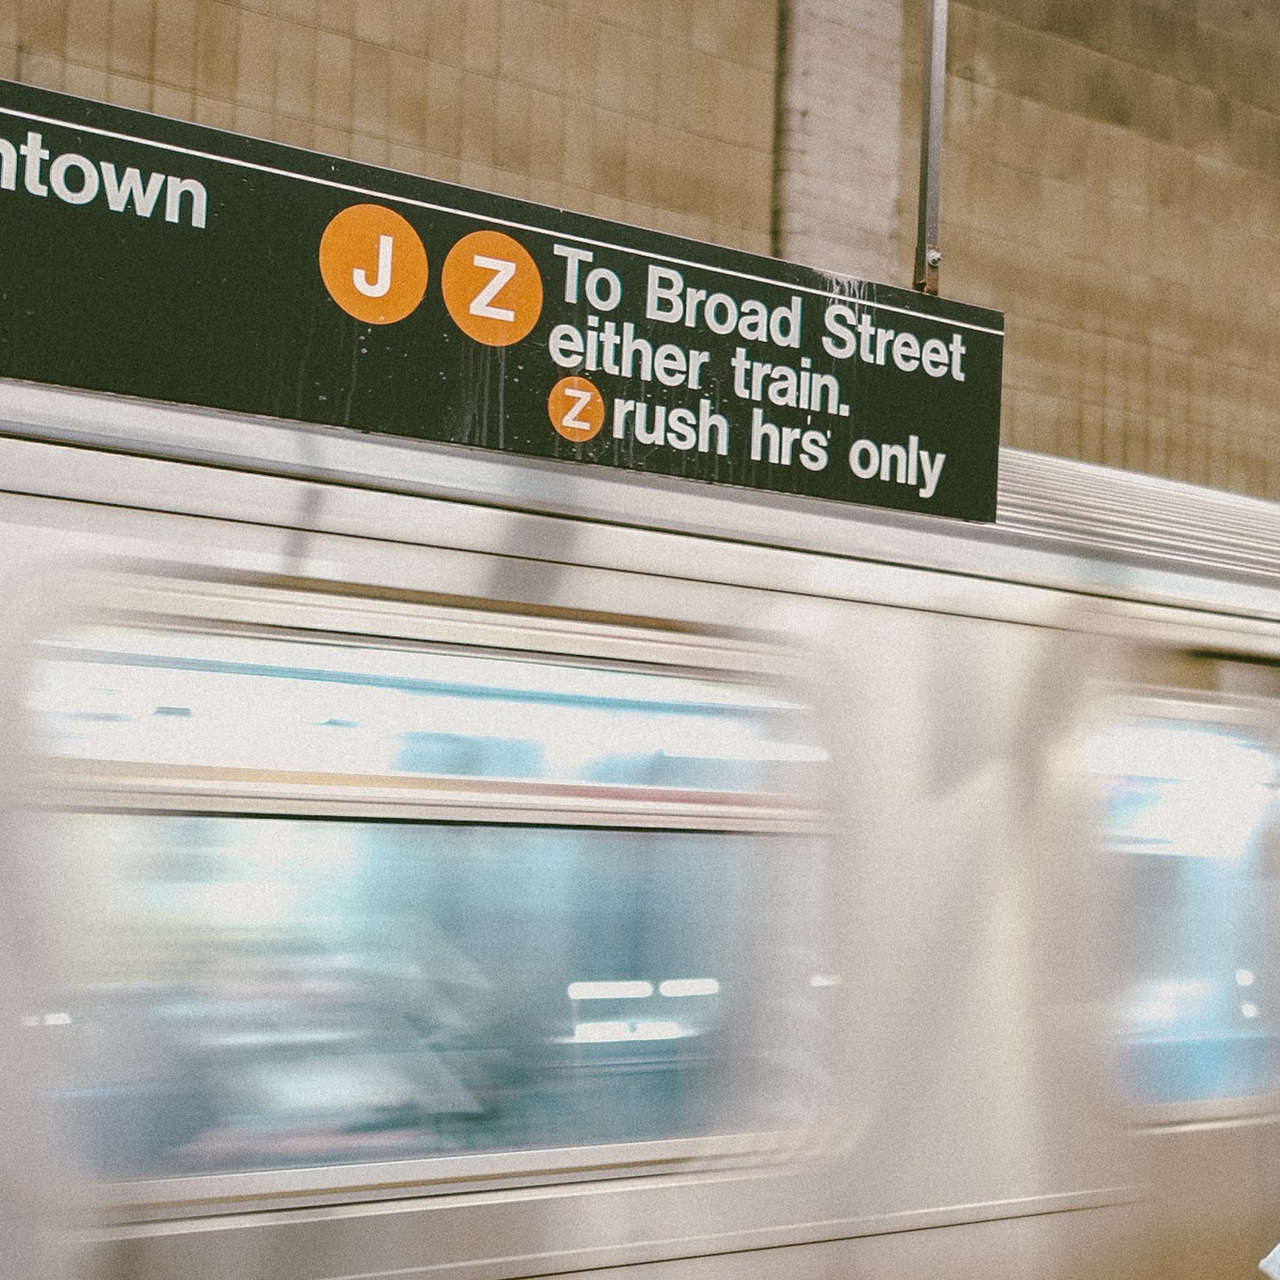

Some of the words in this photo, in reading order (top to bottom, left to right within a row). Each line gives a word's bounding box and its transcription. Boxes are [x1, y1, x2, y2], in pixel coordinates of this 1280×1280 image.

[352, 234, 394, 298] J
[469, 254, 517, 323] Z
[553, 243, 622, 312] To
[645, 264, 802, 349] Broad
[822, 304, 966, 382] Street
[548, 315, 710, 390] either
[731, 346, 851, 417] train.
[561, 387, 593, 431] Z
[612, 398, 729, 456] rush
[750, 407, 829, 471] hrs
[848, 434, 946, 499] only
